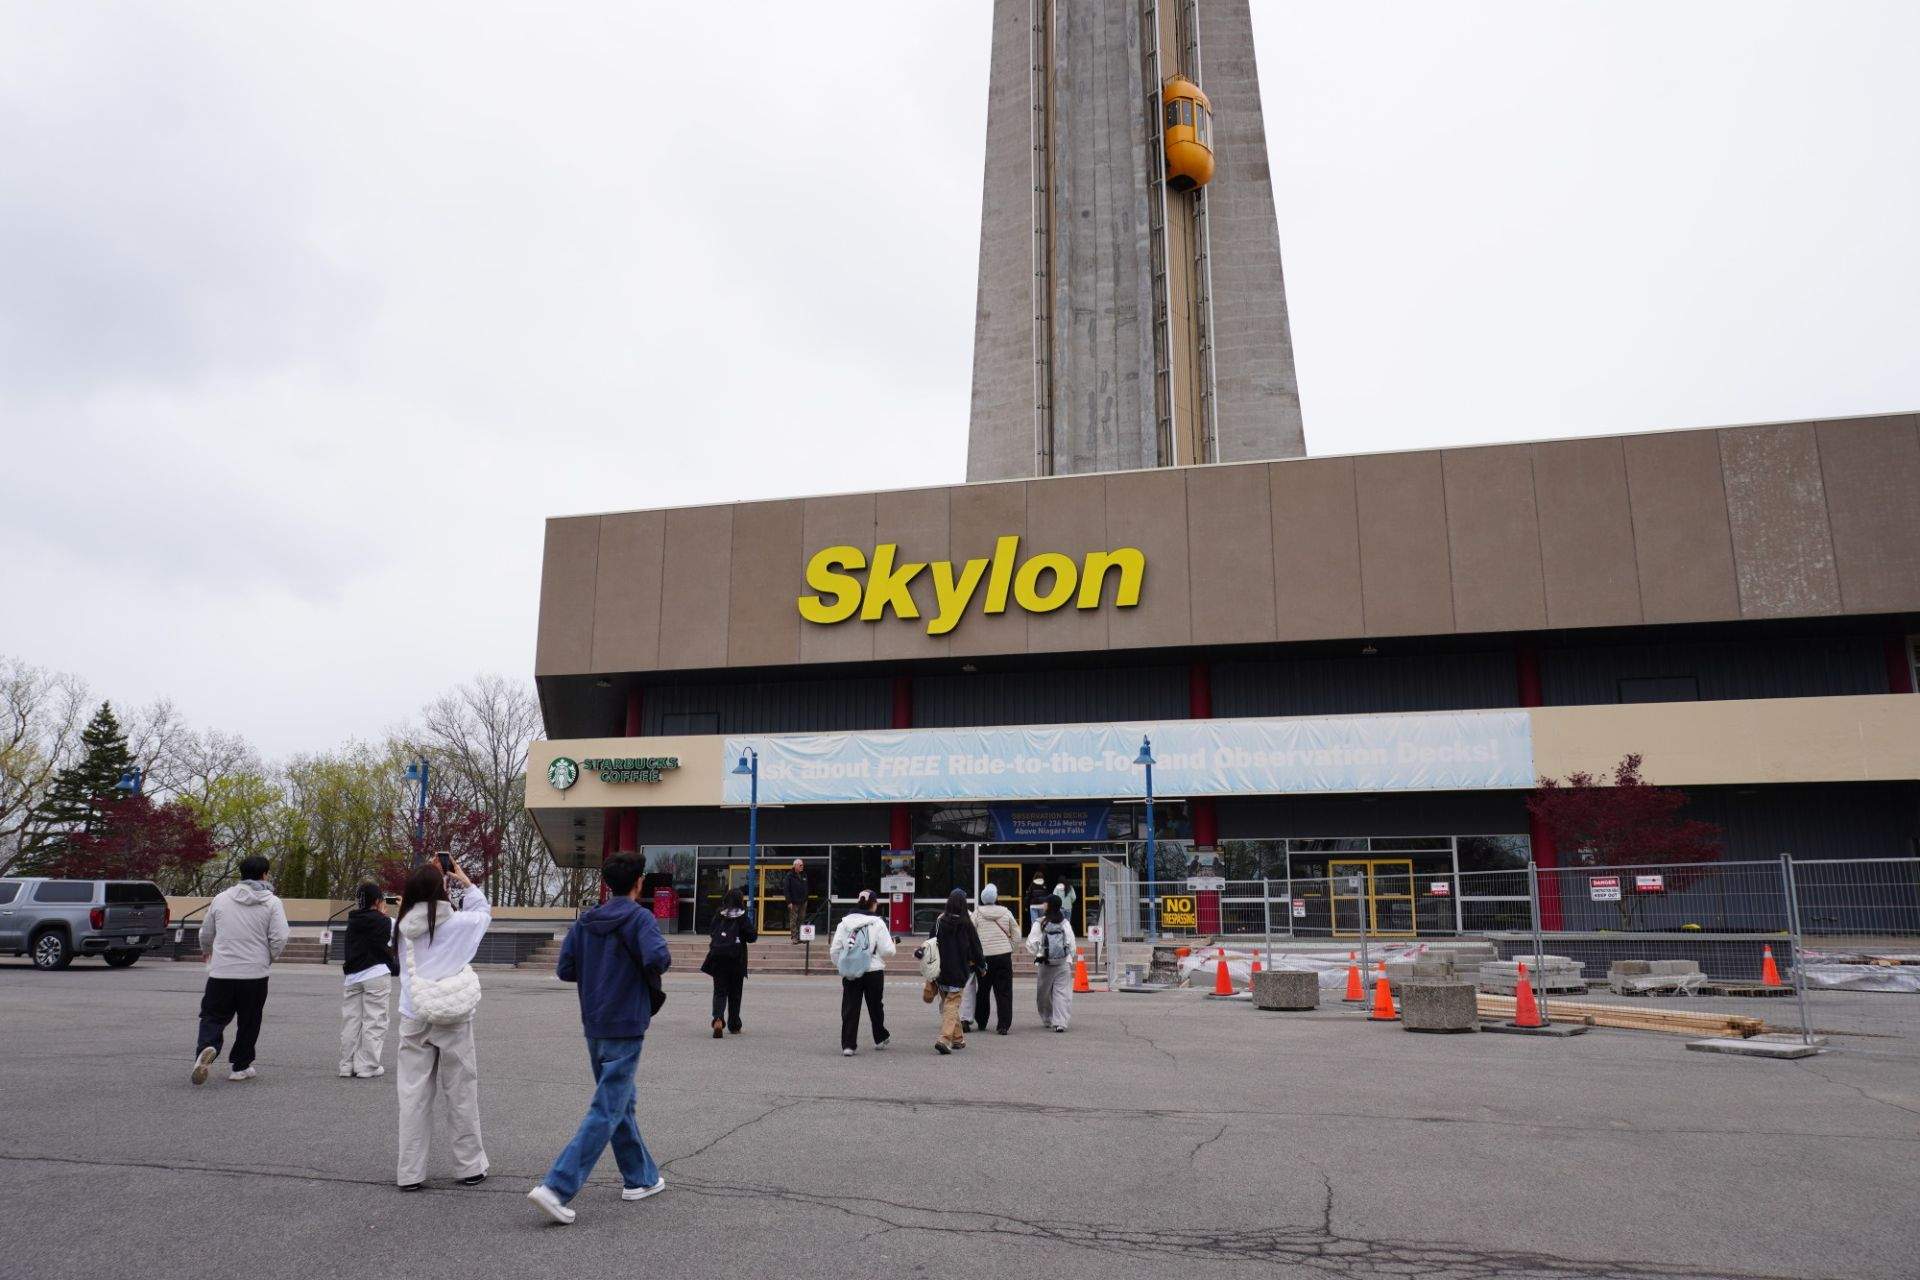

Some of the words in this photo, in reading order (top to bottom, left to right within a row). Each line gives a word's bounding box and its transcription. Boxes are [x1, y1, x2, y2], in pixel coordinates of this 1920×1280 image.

[798, 535, 1146, 635] Skylon
[583, 757, 679, 769] STARBUCKS
[755, 762, 794, 780] sk
[801, 757, 870, 779] about
[877, 754, 942, 778] FREE
[1156, 747, 1205, 770] and
[1214, 743, 1387, 768] Observation
[1399, 738, 1498, 762] Decks!
[601, 770, 662, 783] COFFEE
[1038, 827, 1066, 836] Niagara
[1166, 898, 1191, 912] NO
[1163, 913, 1195, 925] TRESPASSING
